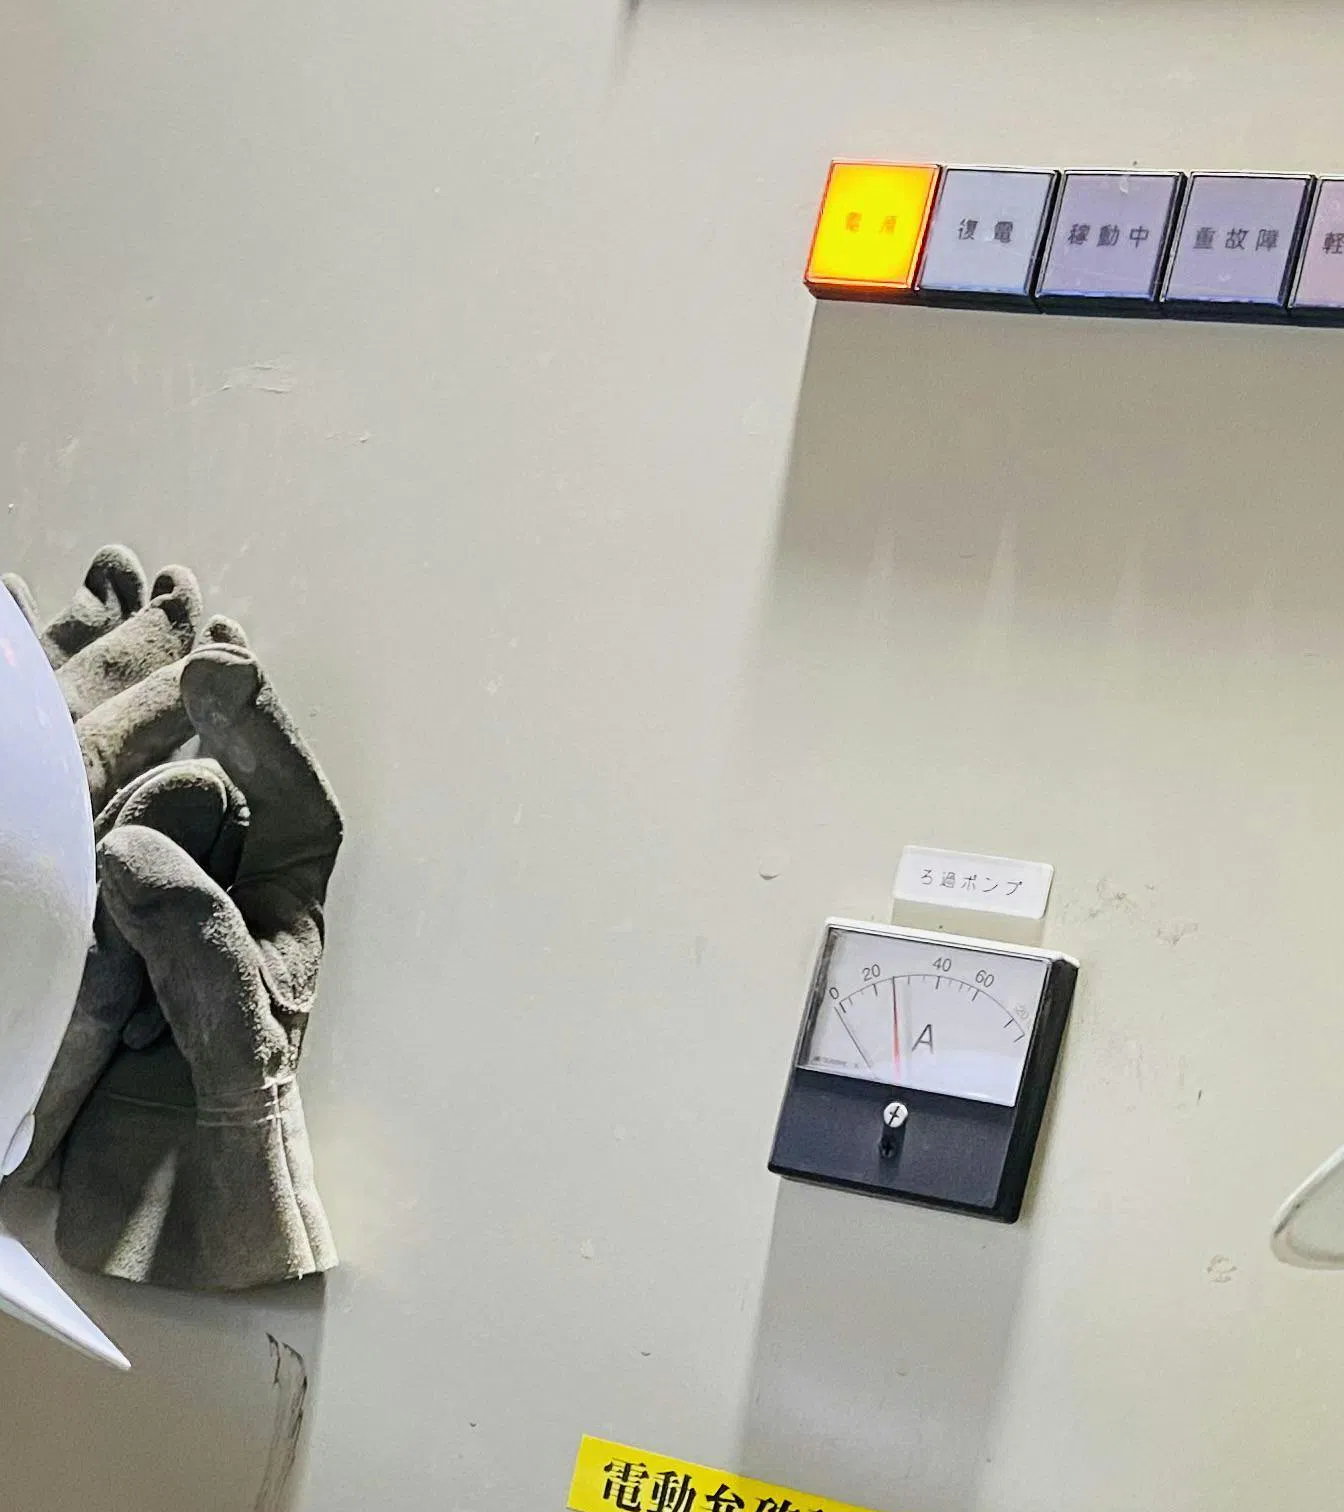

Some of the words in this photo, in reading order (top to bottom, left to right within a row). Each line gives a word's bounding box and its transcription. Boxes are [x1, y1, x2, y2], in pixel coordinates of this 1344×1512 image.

[956, 217, 1013, 244] 復電
[1067, 221, 1150, 250] 稼動中
[1193, 226, 1279, 252] 重故障
[920, 868, 1024, 897] ろ過ポンプ
[828, 985, 841, 1000] 0
[862, 963, 882, 983] 20
[931, 957, 953, 973] 40
[974, 969, 996, 989] 60
[911, 1022, 936, 1055] A
